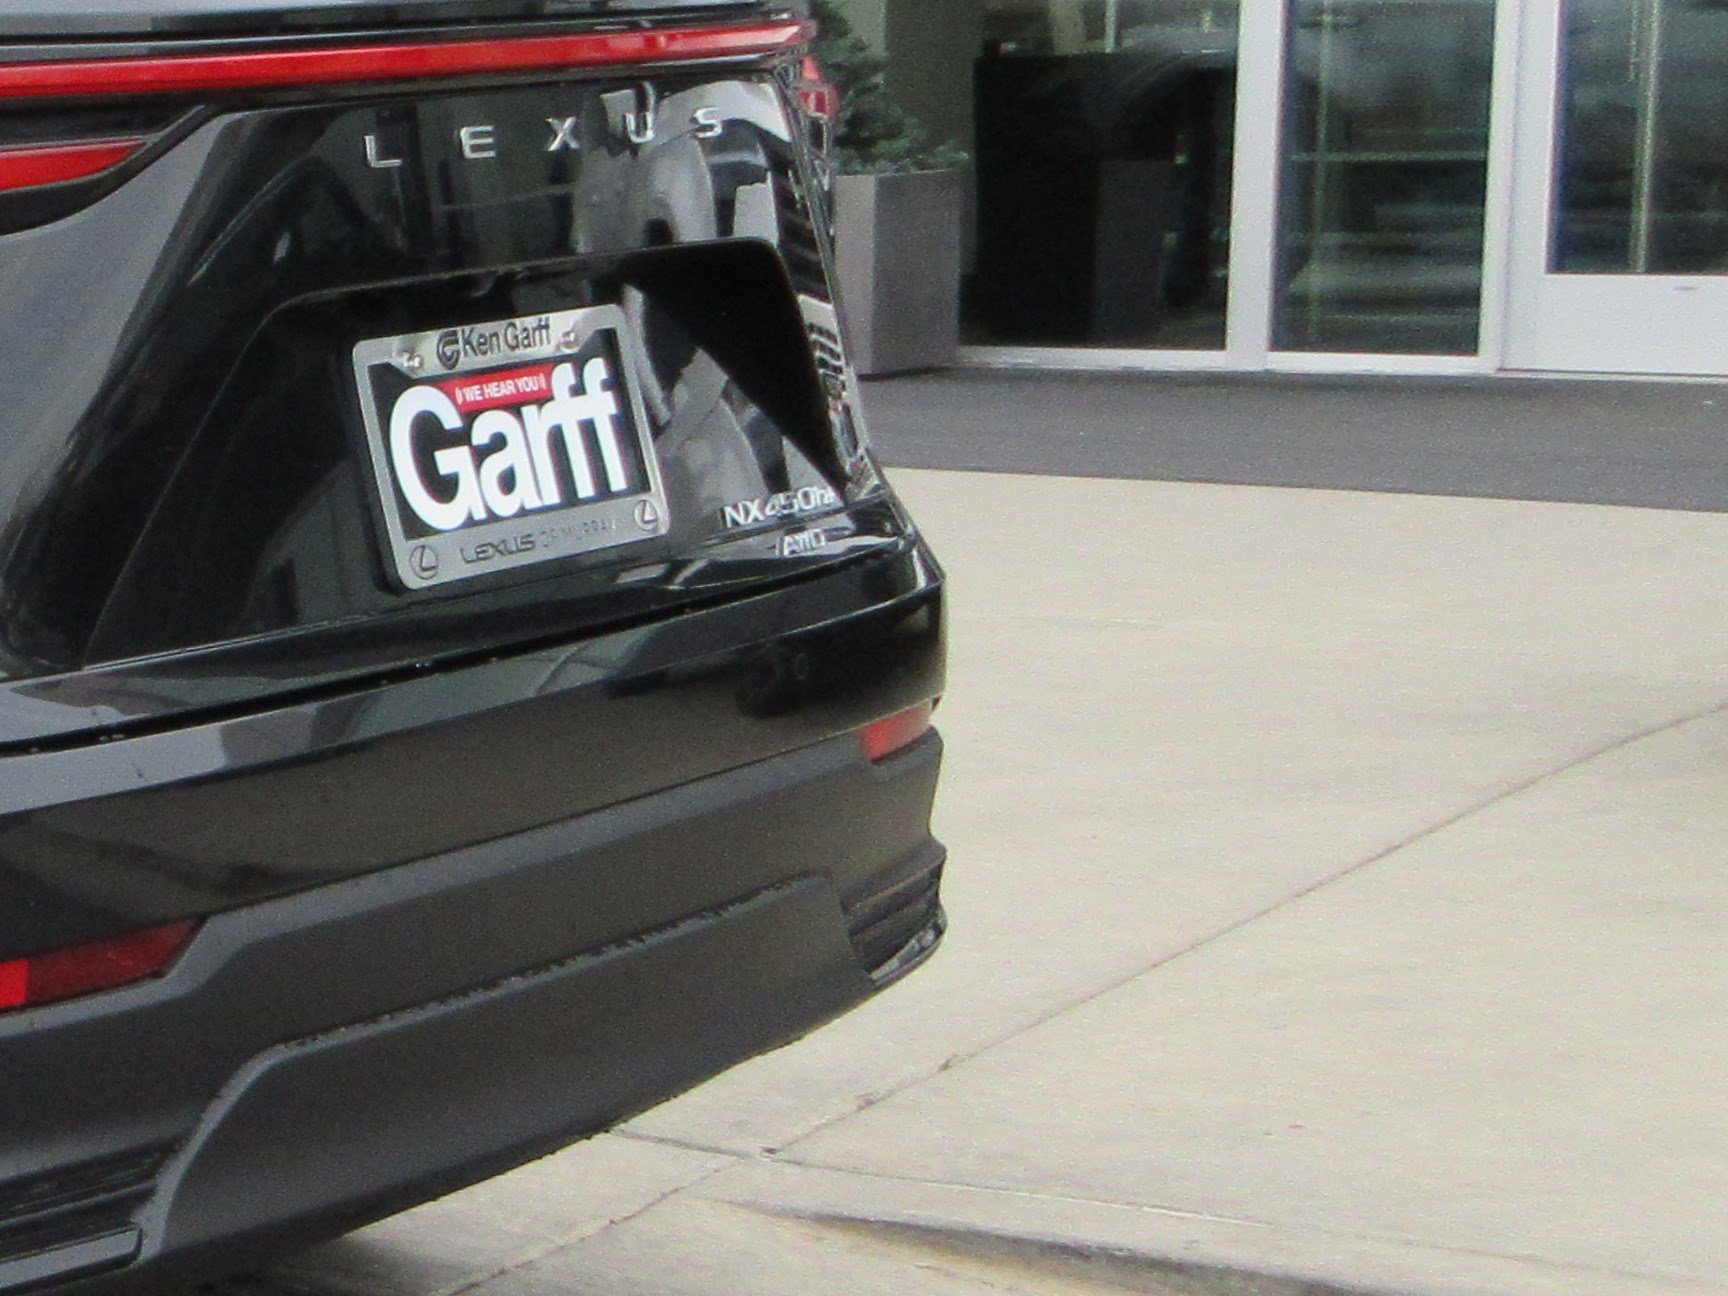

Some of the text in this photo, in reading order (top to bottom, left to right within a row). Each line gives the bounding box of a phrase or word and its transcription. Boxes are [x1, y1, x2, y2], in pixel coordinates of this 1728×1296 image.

[362, 104, 726, 170] LEXUS
[462, 316, 552, 357] Ken Garff
[463, 375, 539, 402] WE HEAR YOU
[389, 357, 628, 532] Garff
[722, 497, 765, 528] NX
[459, 532, 536, 564] LEXUS
